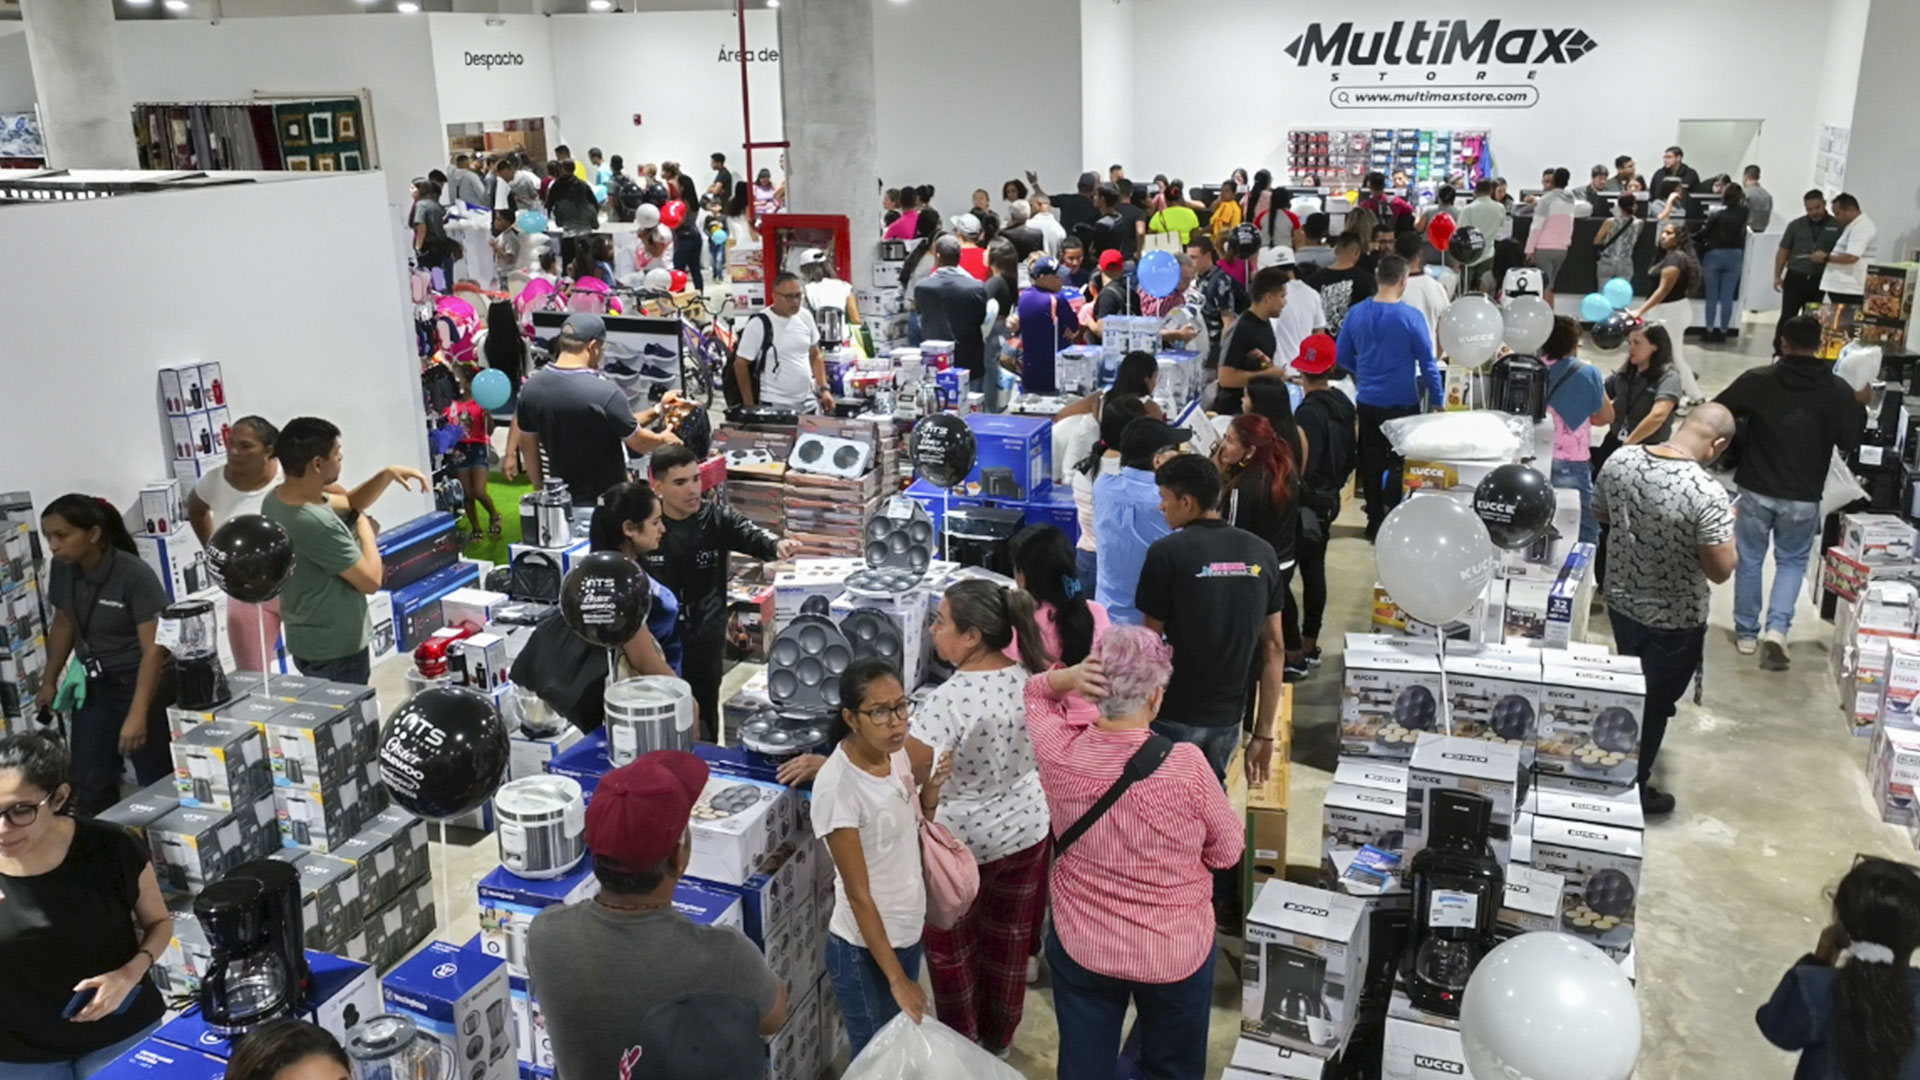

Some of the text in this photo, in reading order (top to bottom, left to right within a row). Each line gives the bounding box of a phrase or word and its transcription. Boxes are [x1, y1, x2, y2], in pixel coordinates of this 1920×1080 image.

[1297, 19, 1576, 66] MultiMax
[718, 44, 780, 62] Área de
[464, 51, 525, 70] Despacho
[1355, 90, 1528, 103] www.multimaxstore.com
[1409, 467, 1445, 477] KUCCE
[1476, 500, 1517, 515] KUCCE
[1412, 774, 1442, 784] KUCCE
[1331, 813, 1358, 823] KUCCE
[1538, 849, 1568, 859] KUCCE
[1248, 928, 1277, 940] KUCCE
[1415, 1056, 1461, 1074] KUCCE
